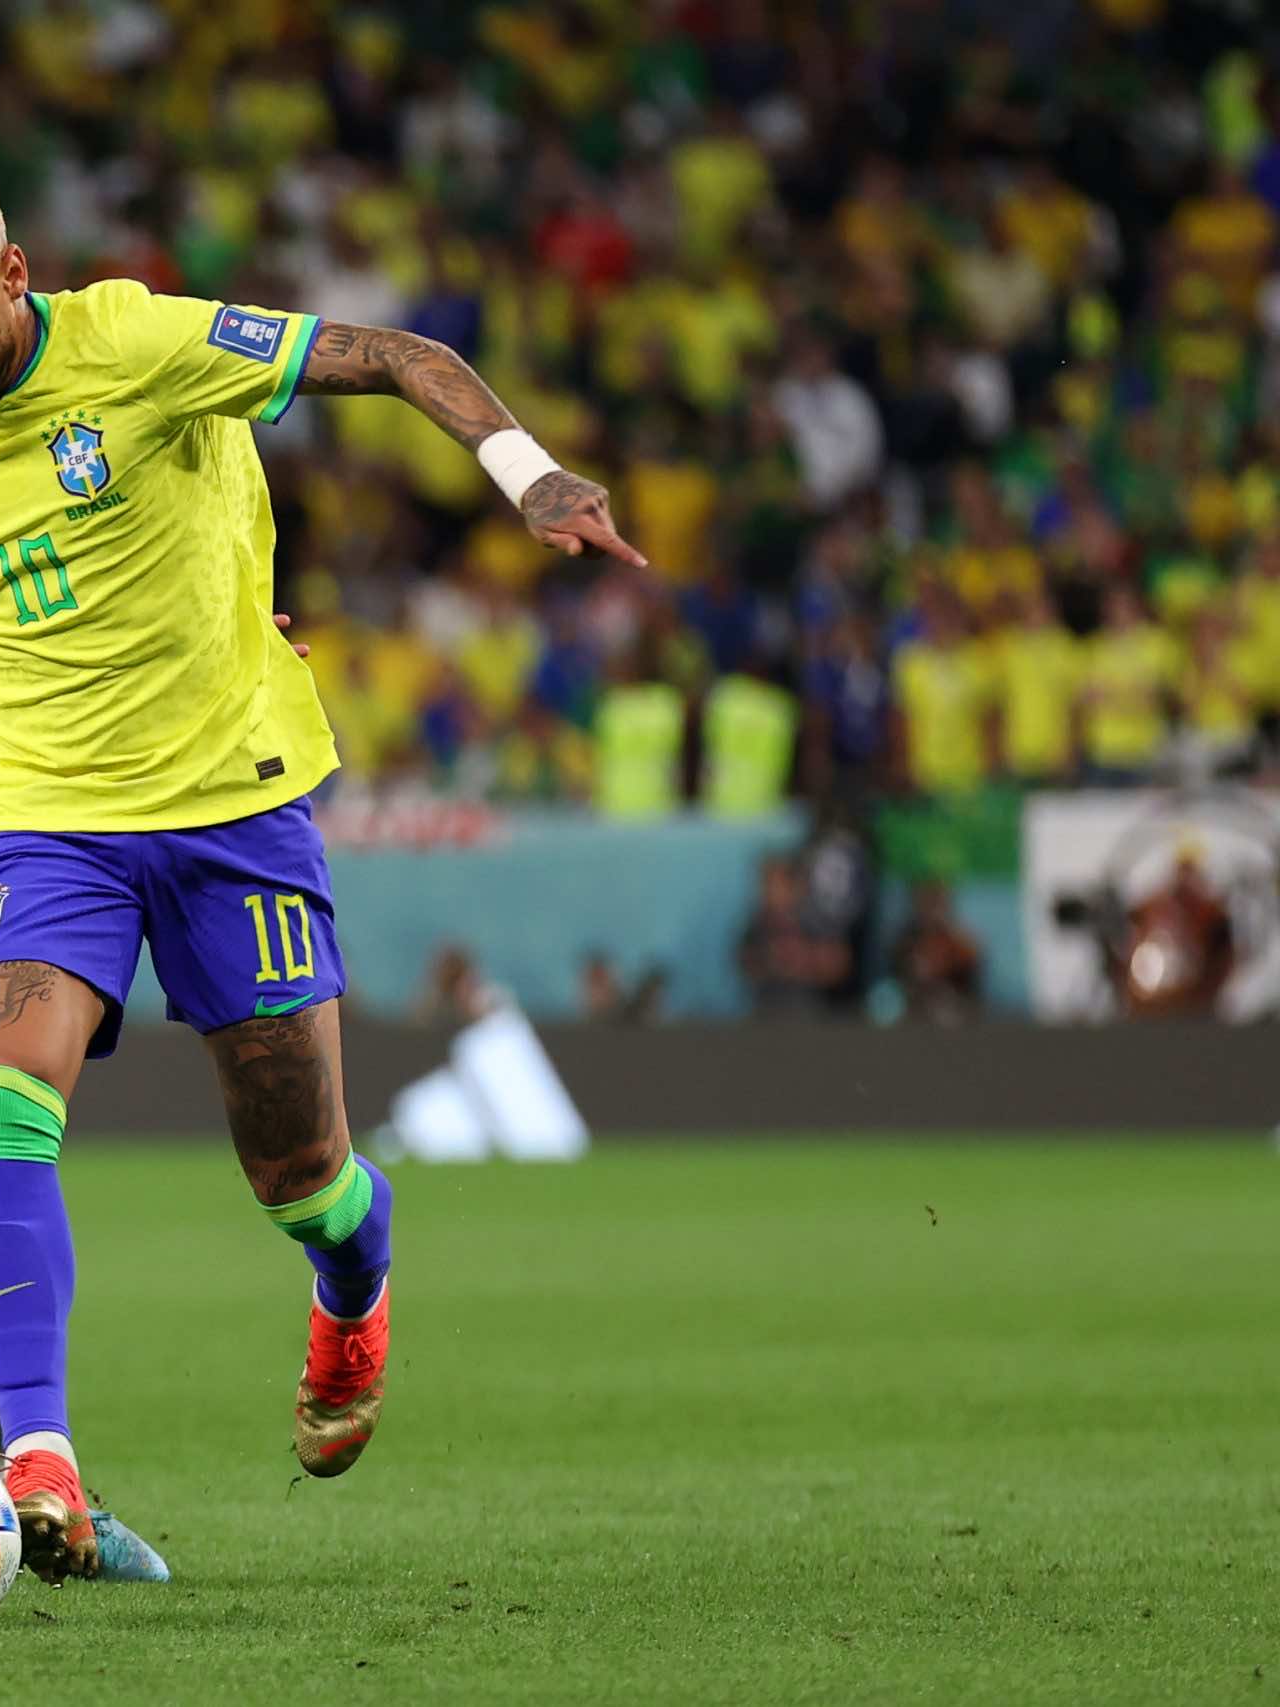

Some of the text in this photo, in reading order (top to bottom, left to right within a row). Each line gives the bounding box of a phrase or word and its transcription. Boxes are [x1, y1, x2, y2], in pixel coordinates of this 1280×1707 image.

[68, 453, 89, 466] CBF
[64, 492, 129, 521] BRASIL
[243, 893, 315, 984] 10
